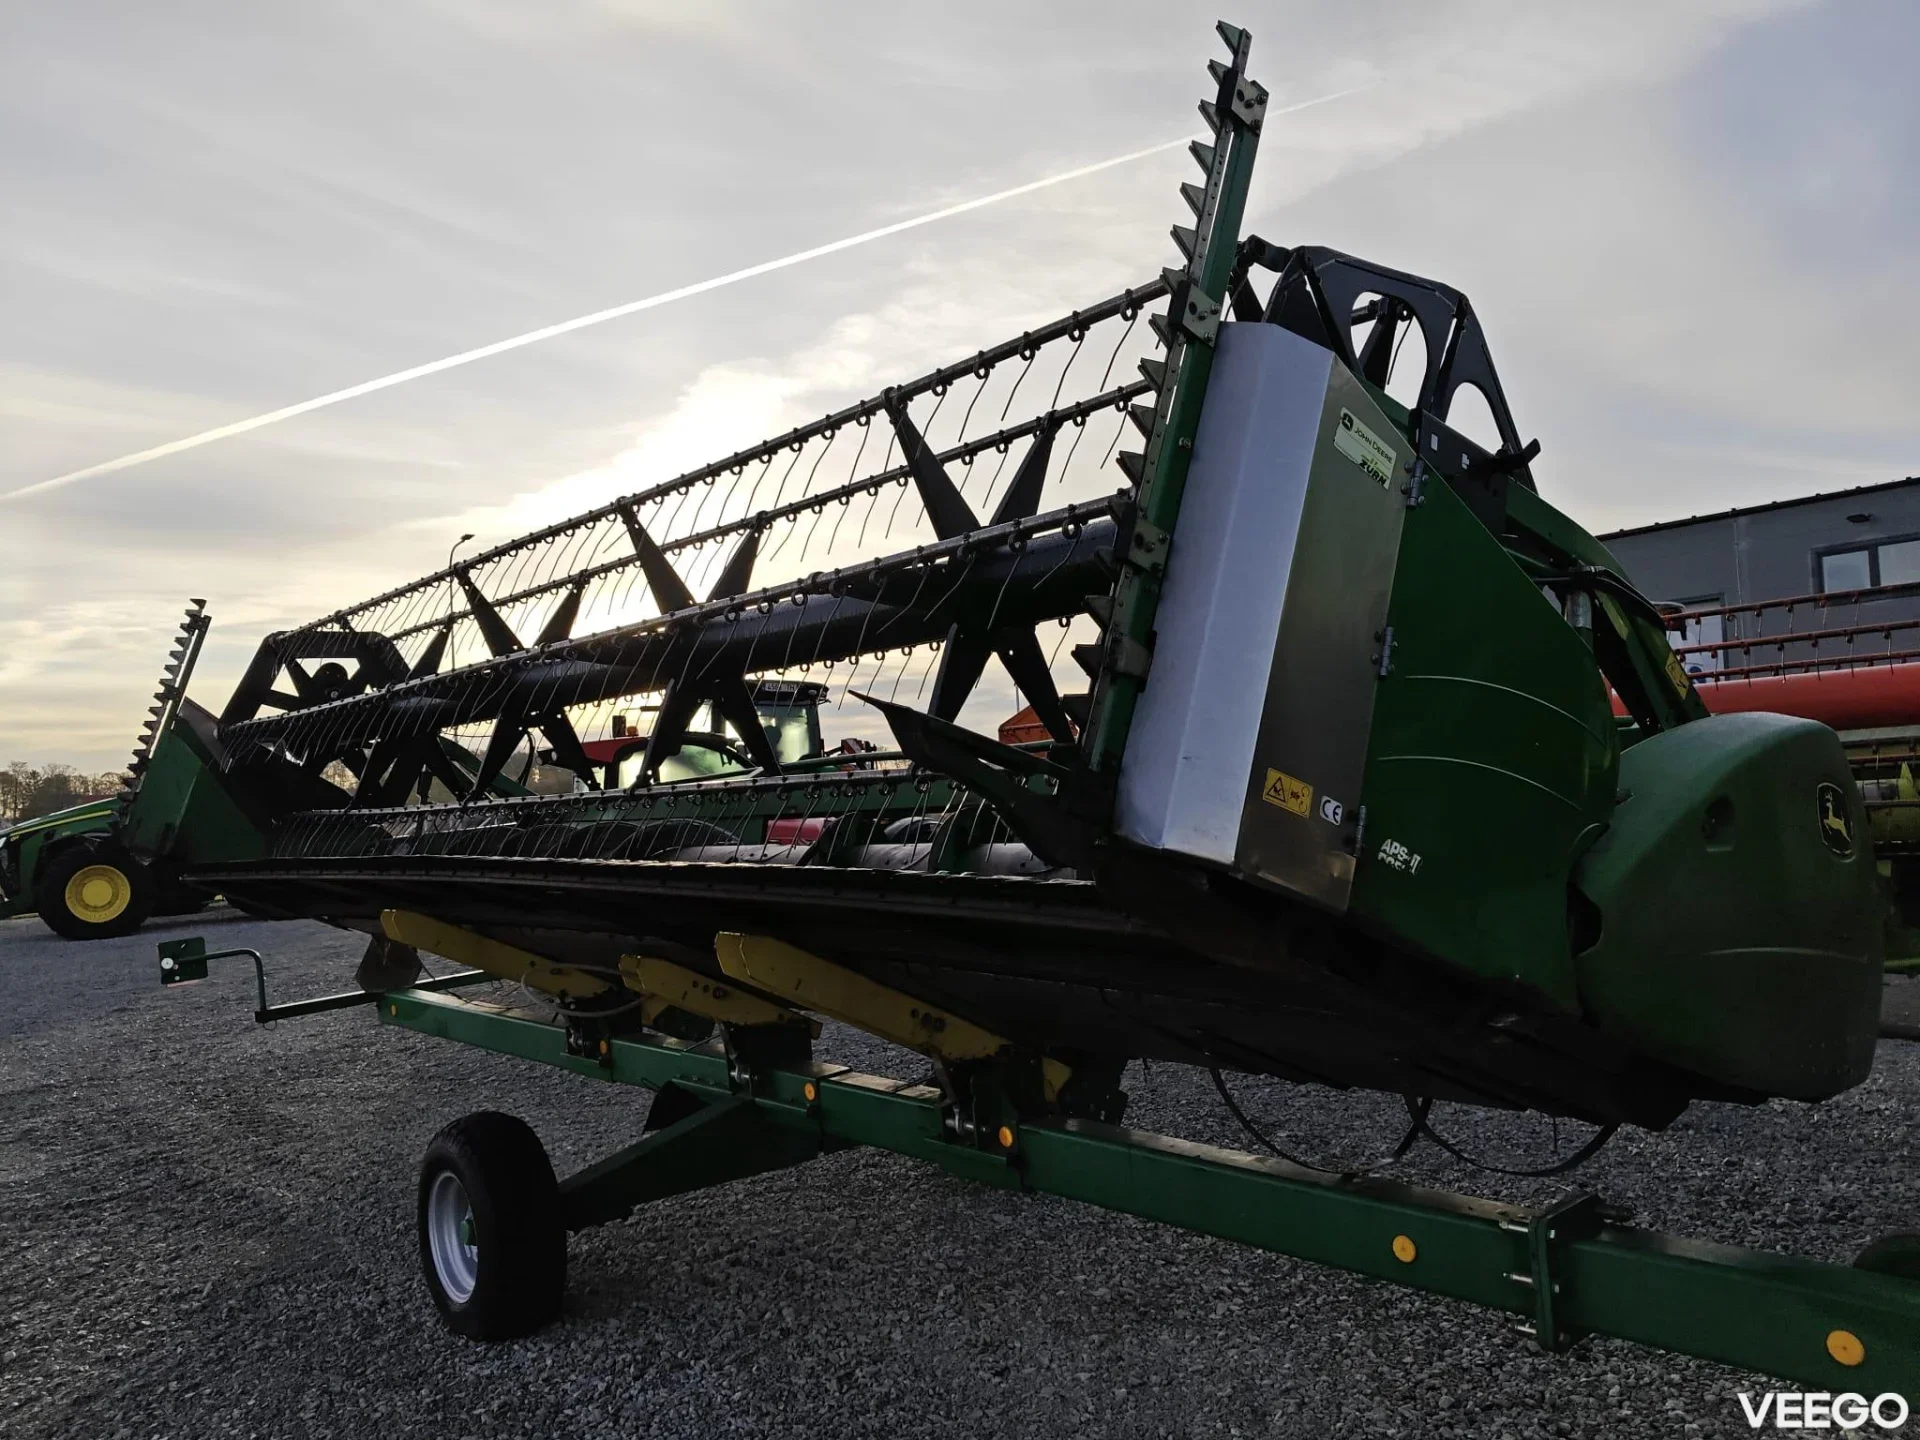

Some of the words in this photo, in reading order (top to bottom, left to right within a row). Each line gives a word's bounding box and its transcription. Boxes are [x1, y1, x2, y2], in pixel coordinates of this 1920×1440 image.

[1354, 428, 1371, 445] JOHN
[1372, 441, 1393, 464] DEERE
[1322, 799, 1342, 824] CE
